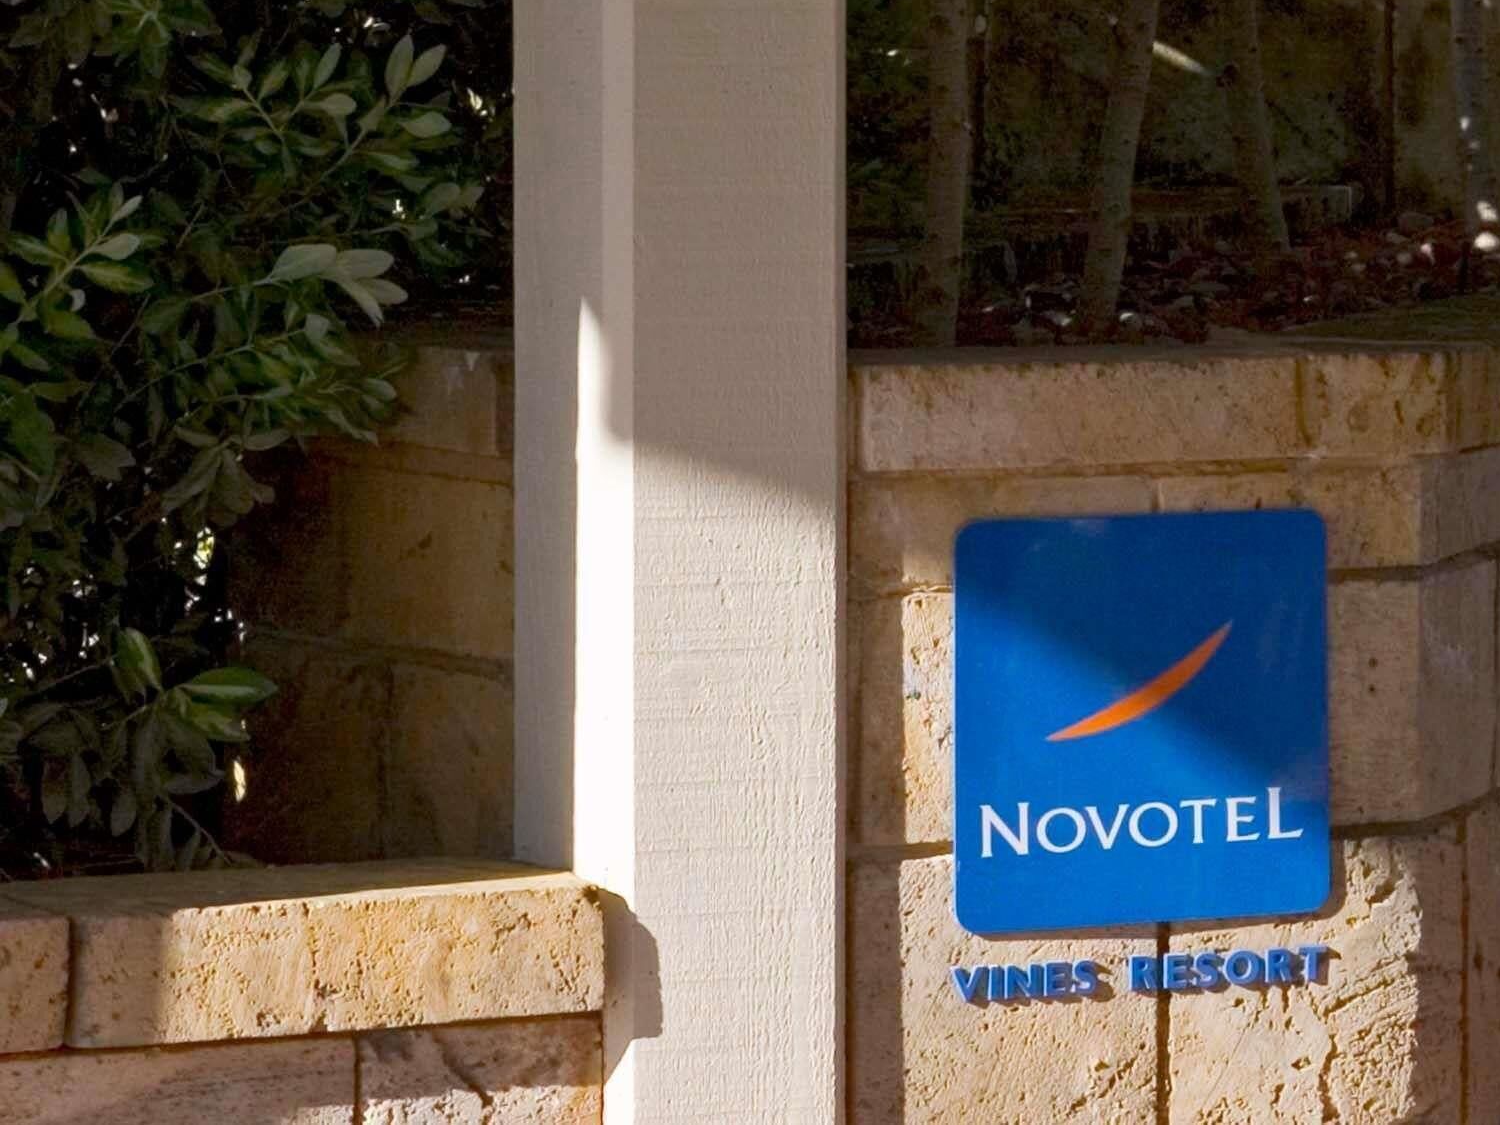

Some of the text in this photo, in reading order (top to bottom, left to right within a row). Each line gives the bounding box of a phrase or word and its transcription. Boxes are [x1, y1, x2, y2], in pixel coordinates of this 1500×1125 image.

[980, 787, 1304, 858] NOVOTEL
[952, 945, 1328, 1001] VINES RESORT
